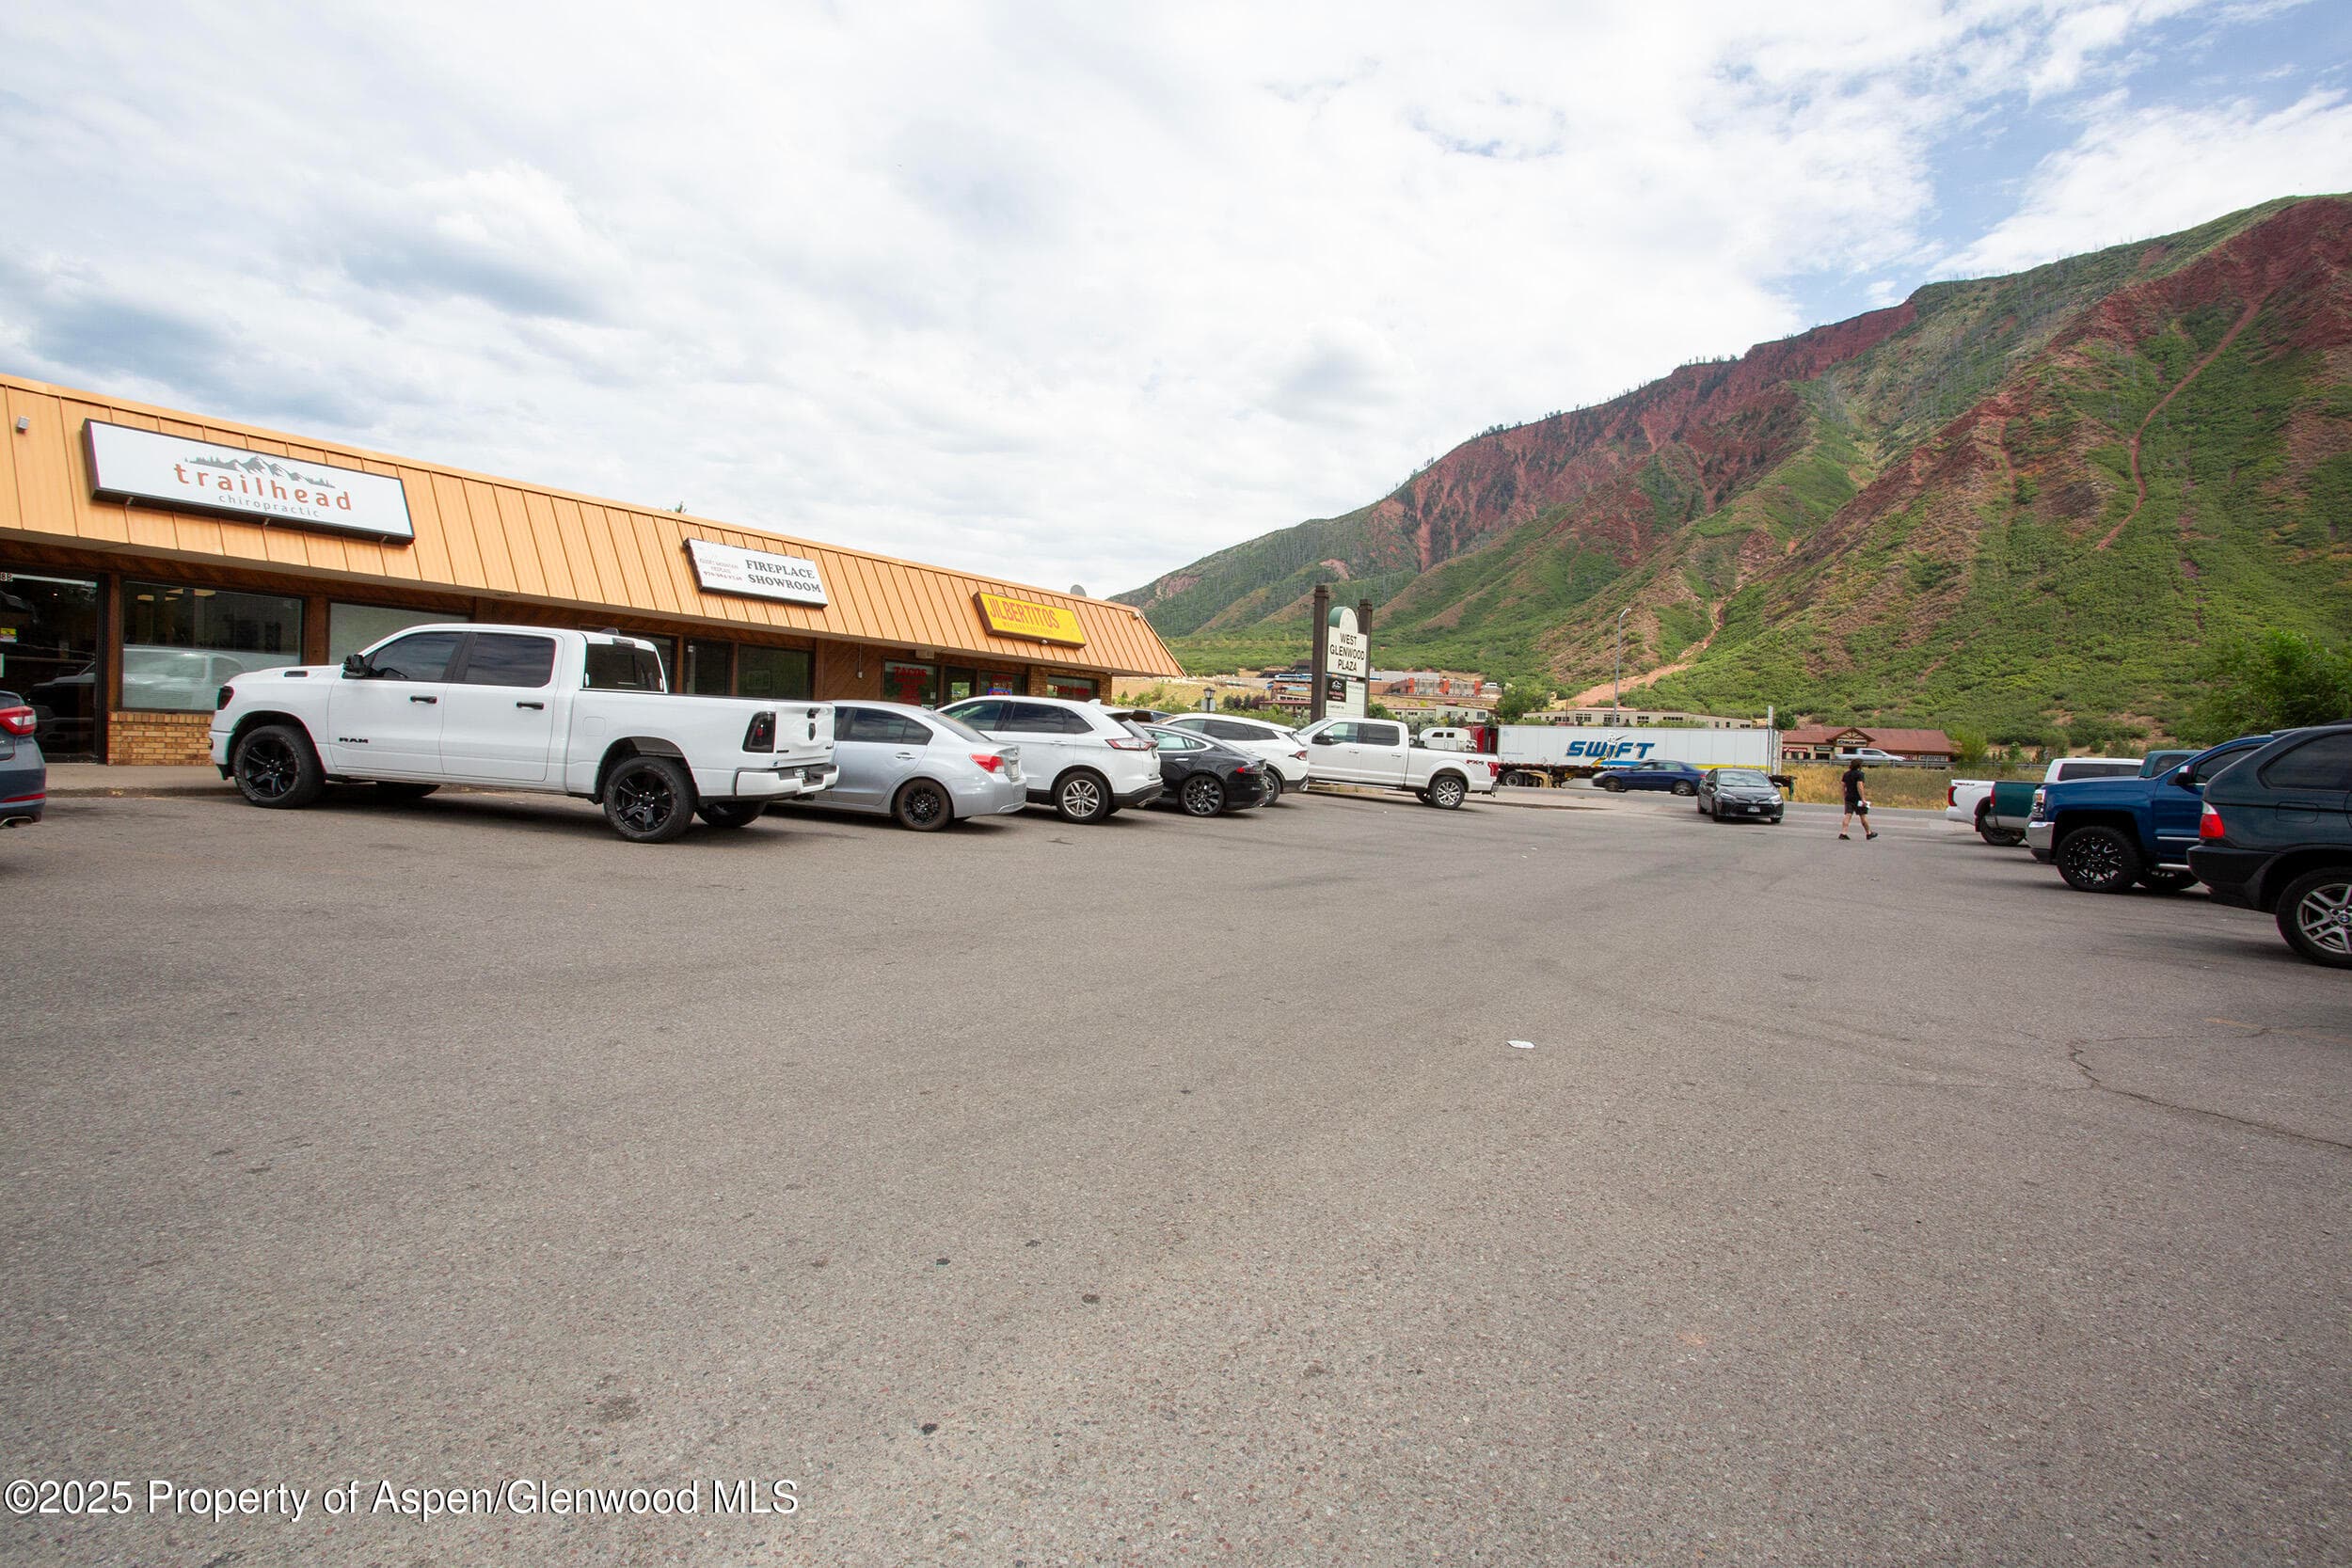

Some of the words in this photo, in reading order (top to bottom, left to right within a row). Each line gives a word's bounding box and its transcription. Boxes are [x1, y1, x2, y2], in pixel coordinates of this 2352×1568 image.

[173, 463, 352, 512] trailhead
[217, 493, 320, 518] chiropractic
[745, 559, 816, 579] FIREPLACE
[748, 574, 822, 594] SHOWROOM
[1340, 632, 1358, 645] WEST
[1329, 643, 1365, 661] GLENWOOD
[894, 666, 927, 677] TACOS
[1337, 658, 1358, 673] PLAZA
[1565, 740, 1656, 759] SWIFT
